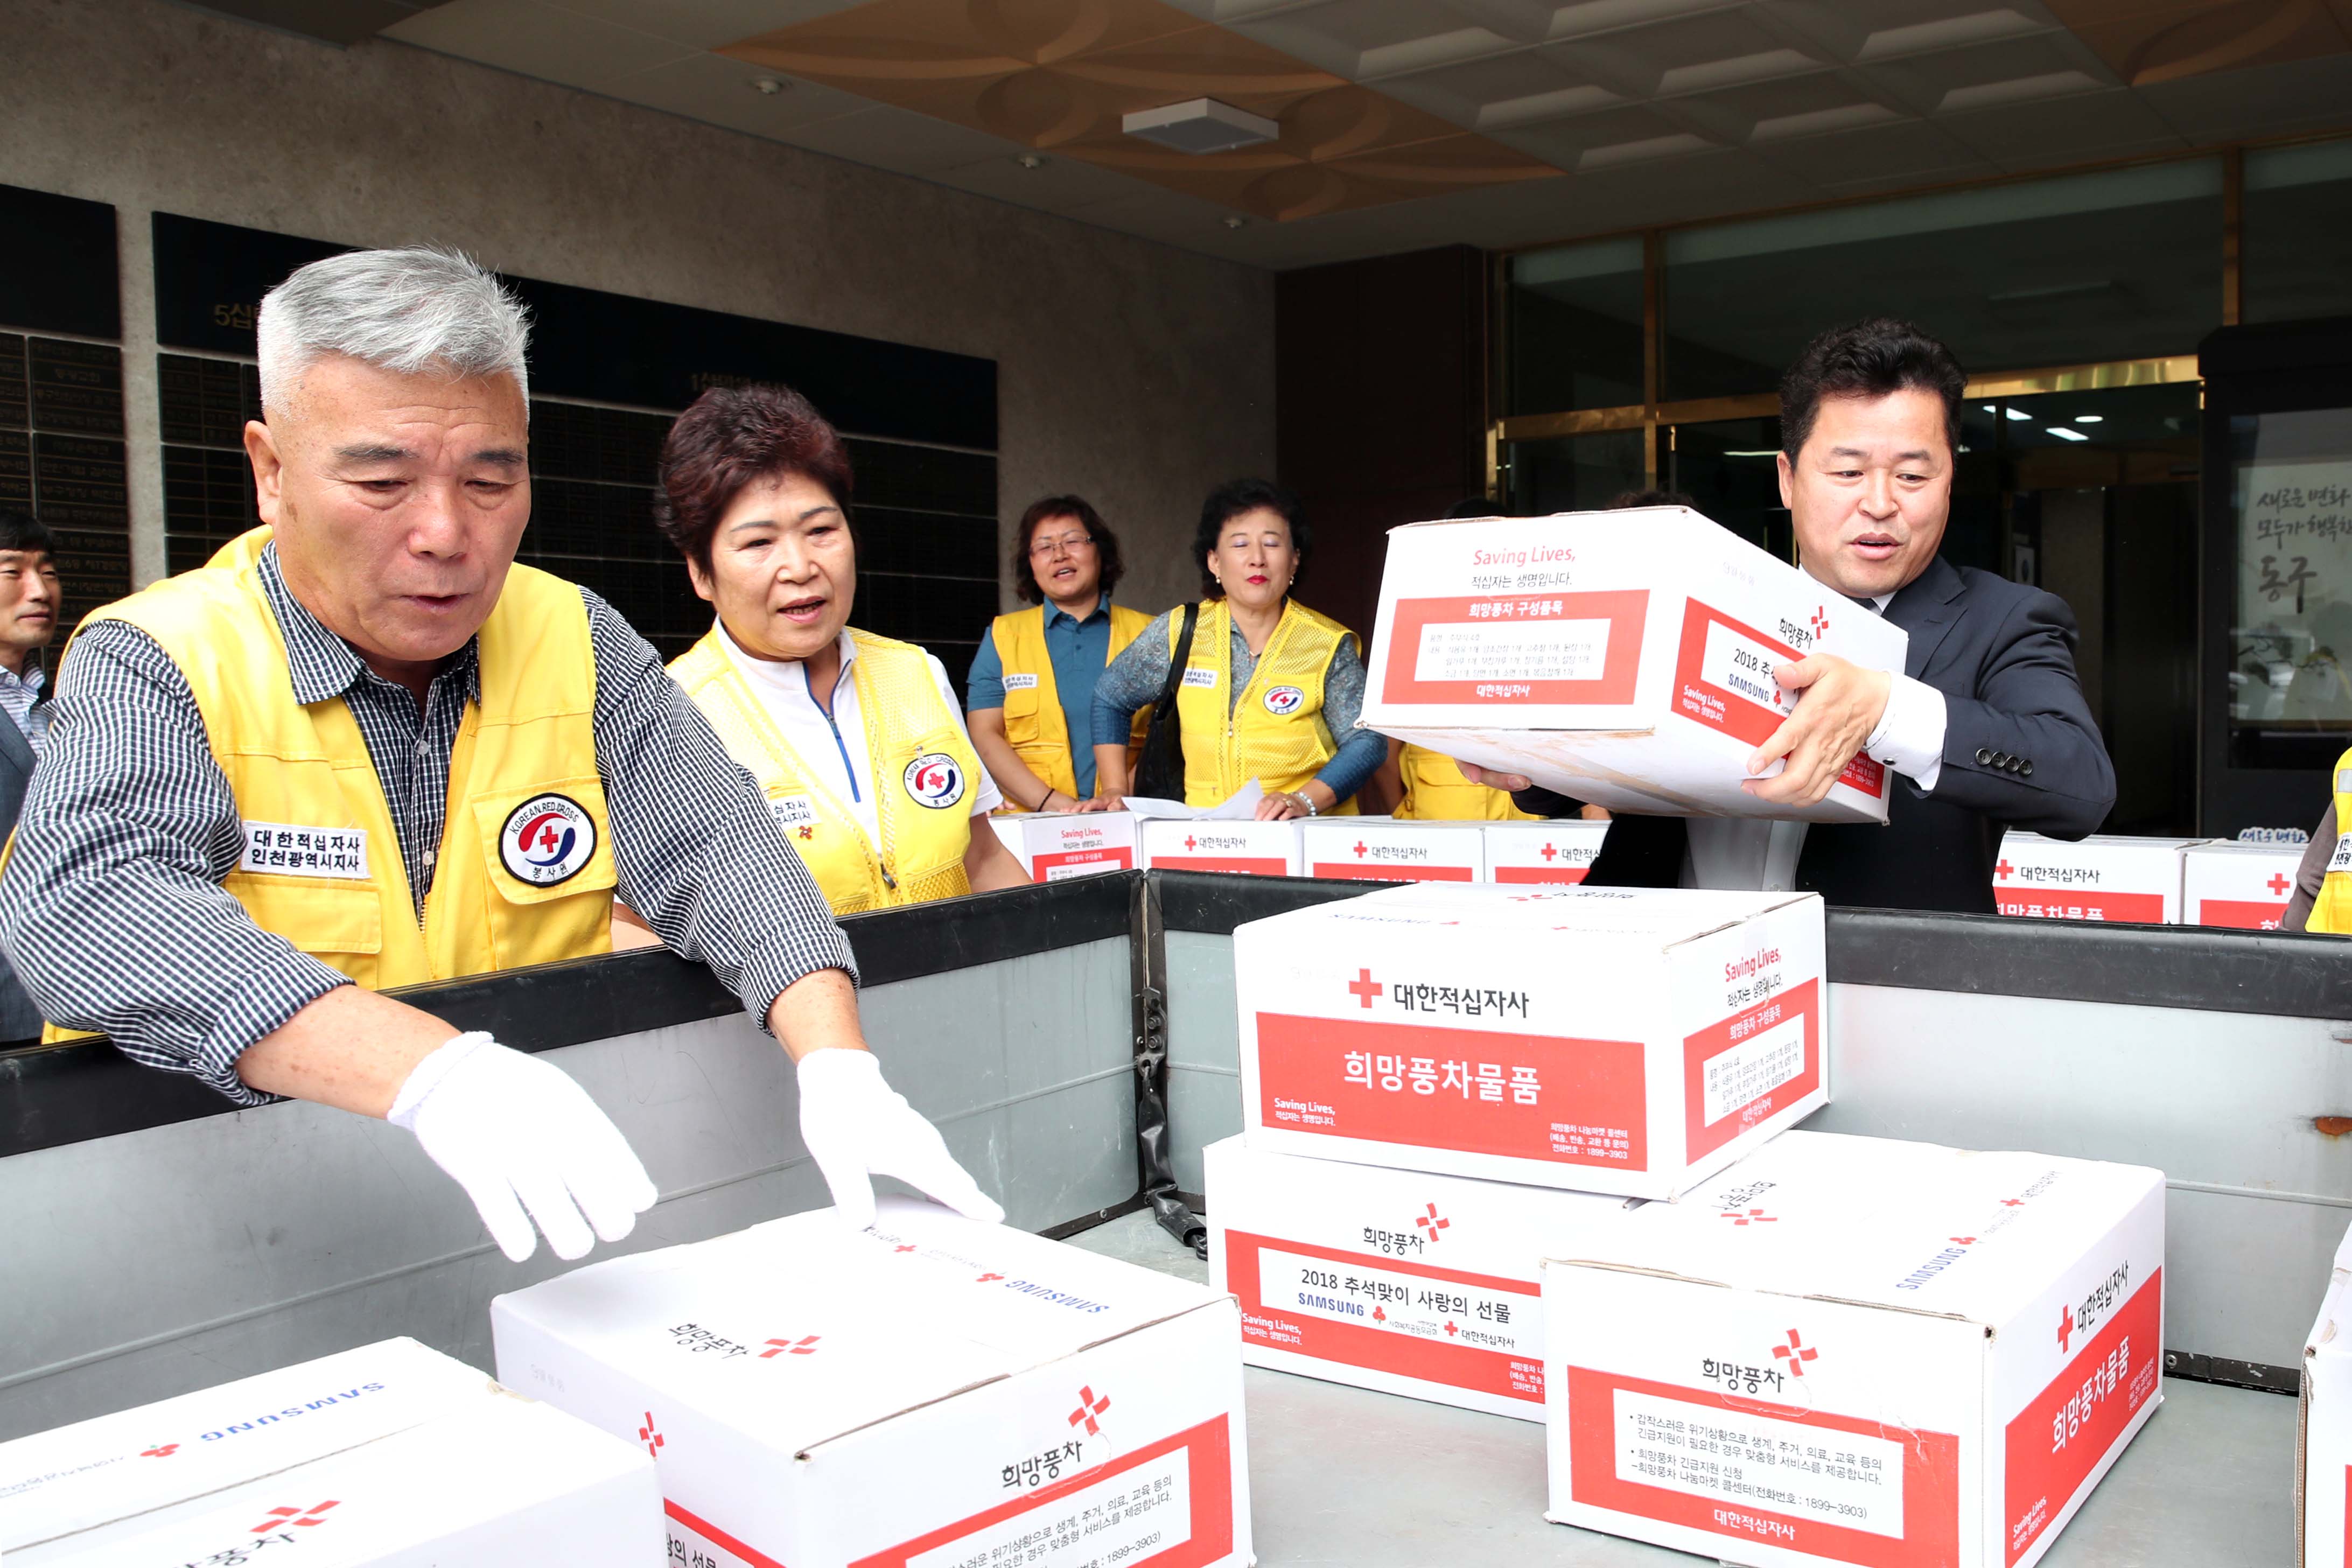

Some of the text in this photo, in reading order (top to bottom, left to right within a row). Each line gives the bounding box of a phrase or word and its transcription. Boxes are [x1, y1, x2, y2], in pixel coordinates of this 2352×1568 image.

[2257, 484, 2351, 513] 새로운 변화
[2257, 519, 2305, 550] 모두가
[1473, 545, 1576, 567] Saving Lives,
[1471, 572, 1572, 589] 적십자는 생명입니다.
[2258, 555, 2318, 614] 동구
[1469, 600, 1563, 618] 희망풍차 구성품목
[1779, 618, 1812, 649] 희망풍차
[1734, 648, 1758, 671] 2018
[1476, 684, 1531, 697] 대한적십자사
[1683, 684, 1726, 712] Saving Lives,
[1728, 673, 1769, 702] SAMSUNG
[510, 801, 579, 835] KOREAN RED CROSS
[254, 830, 360, 853] 대한적십자사
[1061, 827, 1102, 839] Saving Lives,
[1199, 837, 1246, 849] 대한적십자사
[251, 848, 359, 871] 인천광역시지사
[1372, 846, 1427, 859] 대한적십자사
[2020, 866, 2100, 883] 대한적십자사
[1327, 913, 1431, 926] SAMSUNG
[1725, 948, 1781, 982] Saving Lives,
[1394, 983, 1529, 1018] 대한적십자사
[1727, 986, 1751, 1008] 적십자는
[1730, 1004, 1781, 1040] 희망풍차 구성품목
[1344, 1051, 1541, 1104] 희망풍차물품
[1275, 1097, 1335, 1116] Saving Lives,
[1275, 1110, 1335, 1126] 적십자는 생명입니다.
[1550, 1133, 1629, 1149] (배송, 반송, 교환 등 문의)
[1551, 1123, 1628, 1138] 희망풍차 나눔마켓 콜센터
[1552, 1144, 1579, 1154] 전화번호
[1587, 1148, 1628, 1159] 1899-3903
[1711, 1181, 1777, 1210] 희망풍차
[1363, 1226, 1425, 1256] 희망풍차
[1895, 1248, 1967, 1290] SAMSUNG
[1005, 1280, 1110, 1314] SAMSUNG
[1298, 1292, 1364, 1317] SAMSUNG
[1301, 1269, 1511, 1324] 2018 추석맞이 사랑의 선물
[2077, 1260, 2129, 1333] 대한적십자사
[1242, 1313, 1301, 1335] Saving Lives,
[1243, 1325, 1302, 1346] 적십자는 생명입니다.
[668, 1324, 750, 1359] 희망풍차
[1461, 1329, 1515, 1349] 대한적십자사
[1510, 1361, 1536, 1374] 희망풍차
[1703, 1358, 1784, 1394] 희망풍차
[1512, 1381, 1538, 1394] 전화번호
[2052, 1335, 2130, 1453] 희망풍차물품
[200, 1382, 386, 1441] SAMSUNG
[1637, 1413, 1882, 1471] 갑작스러운 위기상황으로 생계, 주거, 의료, 교육 등의
[1637, 1427, 1882, 1486] 긴급지원이 필요한 경우 맞춤형 서비스를 제공합니다.
[1002, 1440, 1083, 1488] 희망풍차
[1638, 1448, 1742, 1480] 희망풍차 긴급지원 신청
[1680, 1471, 1719, 1489] 나눔마켓
[1805, 1497, 1867, 1519] 1899-3903)
[992, 1474, 1172, 1559] 위기상황으로 생계, 주거, 의료, 교육 등의
[1027, 1544, 1047, 1561] 경우
[1051, 1530, 1080, 1551] 맞춤형
[1083, 1511, 1121, 1536] 서비스를
[1124, 1490, 1172, 1518] 제공합니다.
[1713, 1508, 1796, 1541] 대한적십자사
[2013, 1512, 2032, 1538] Saving
[1107, 1531, 1161, 1563] 1899-3903)
